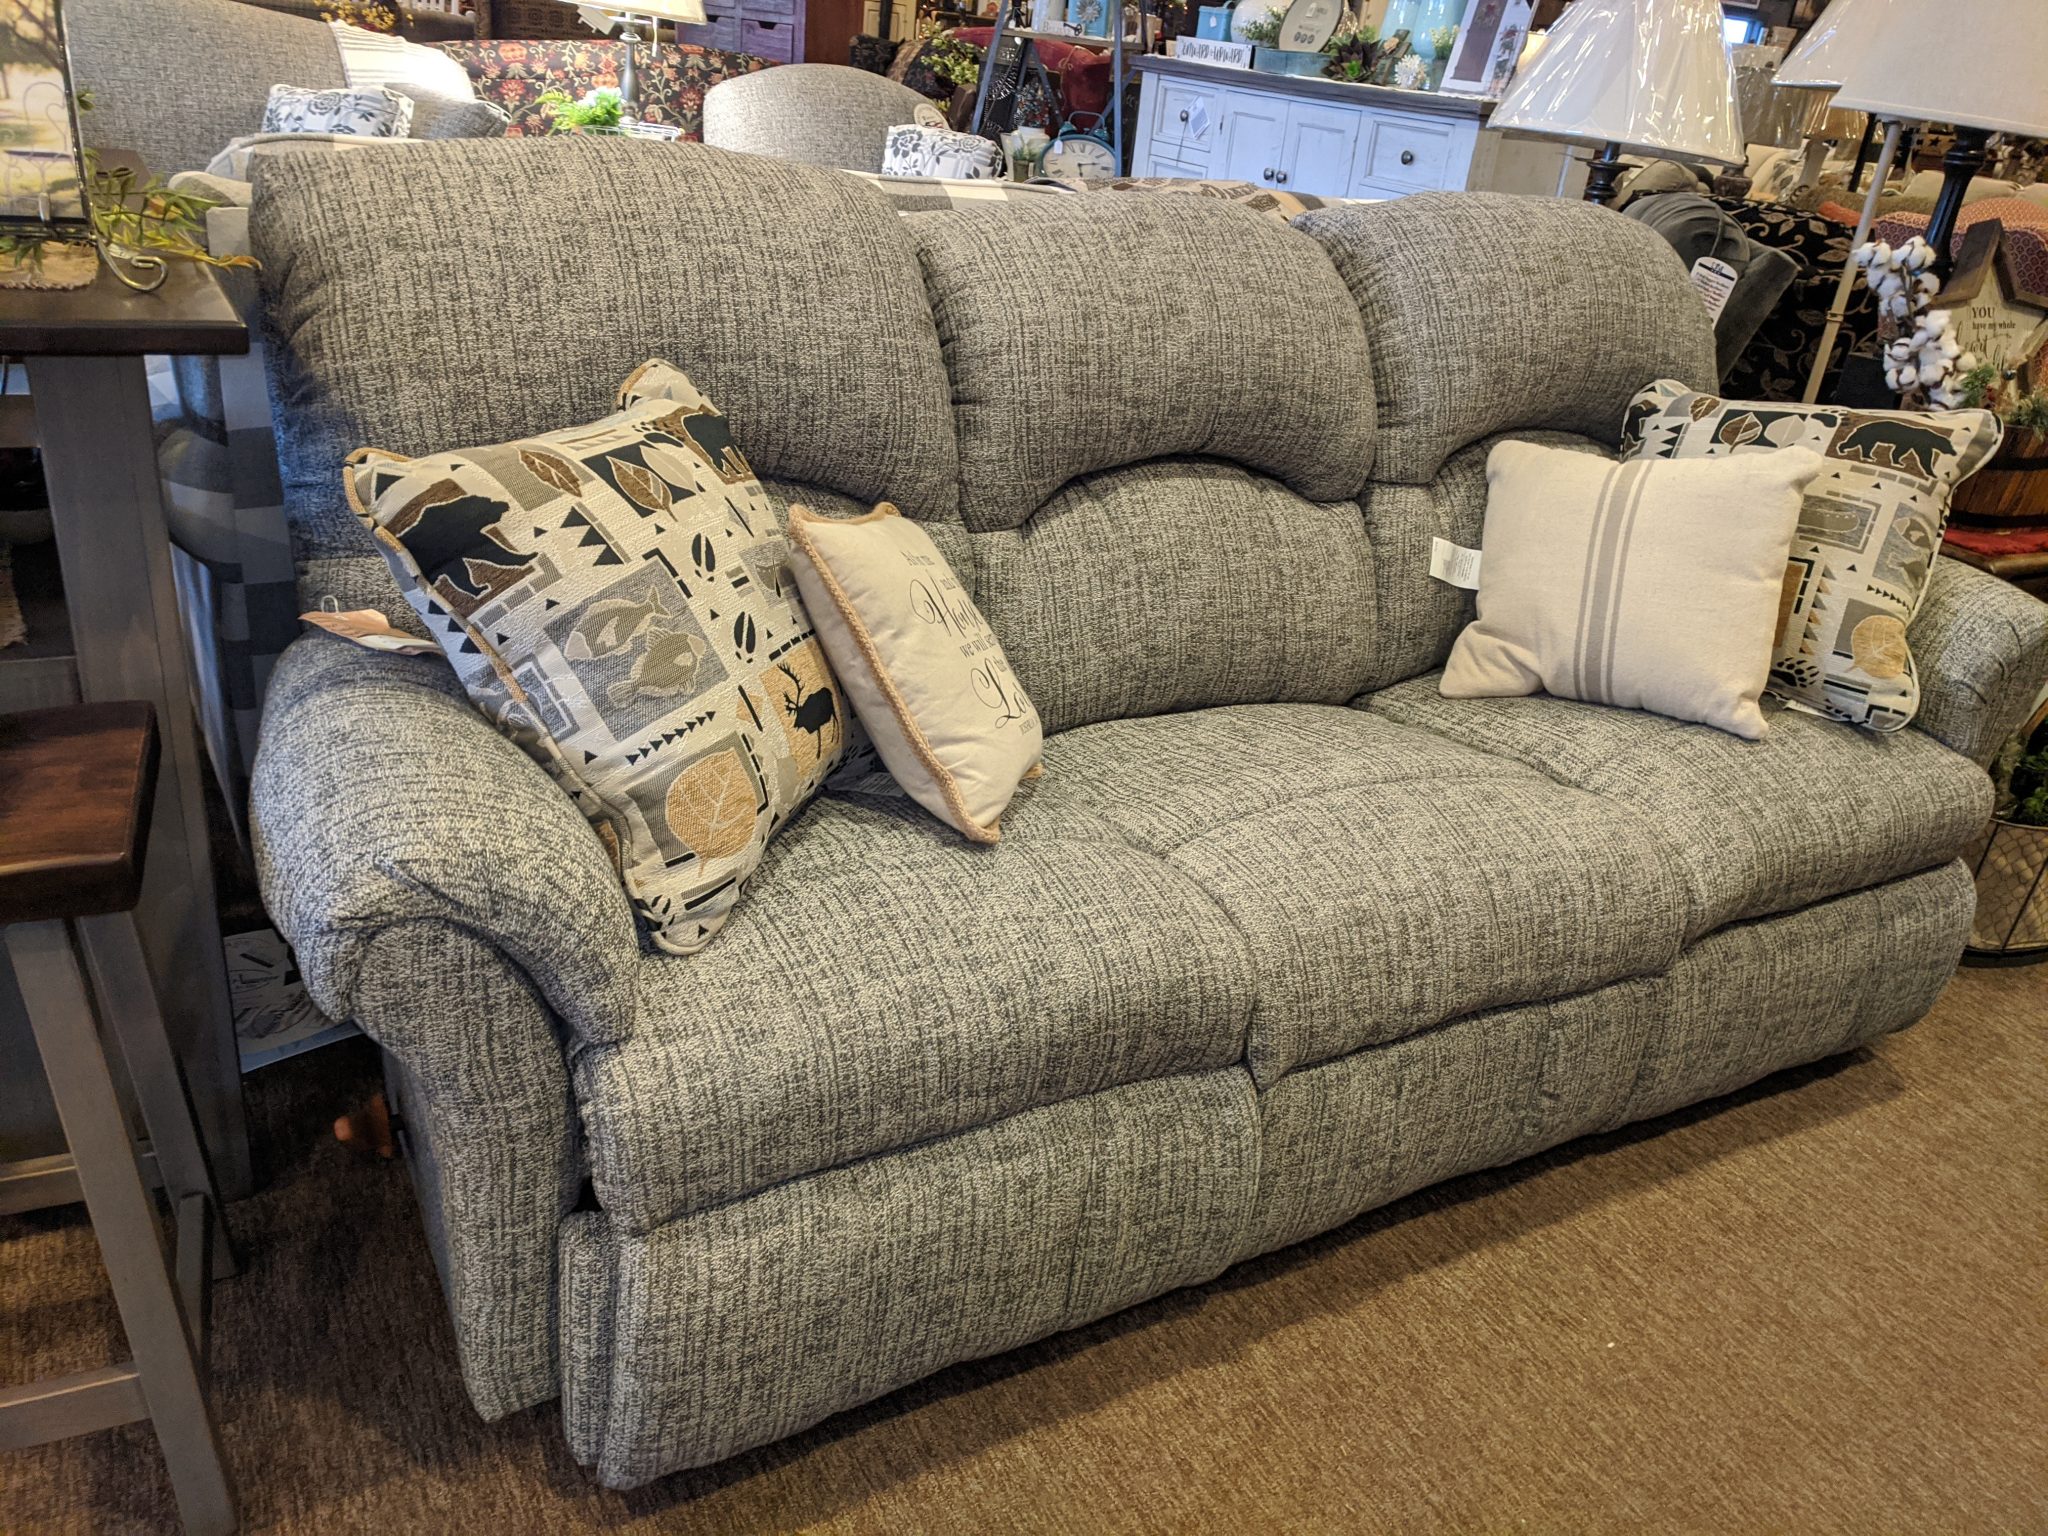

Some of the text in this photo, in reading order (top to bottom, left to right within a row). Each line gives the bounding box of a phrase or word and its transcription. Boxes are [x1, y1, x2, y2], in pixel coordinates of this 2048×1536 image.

[1972, 307, 1995, 318] YOU
[1998, 320, 2016, 329] whole
[959, 641, 973, 658] we
